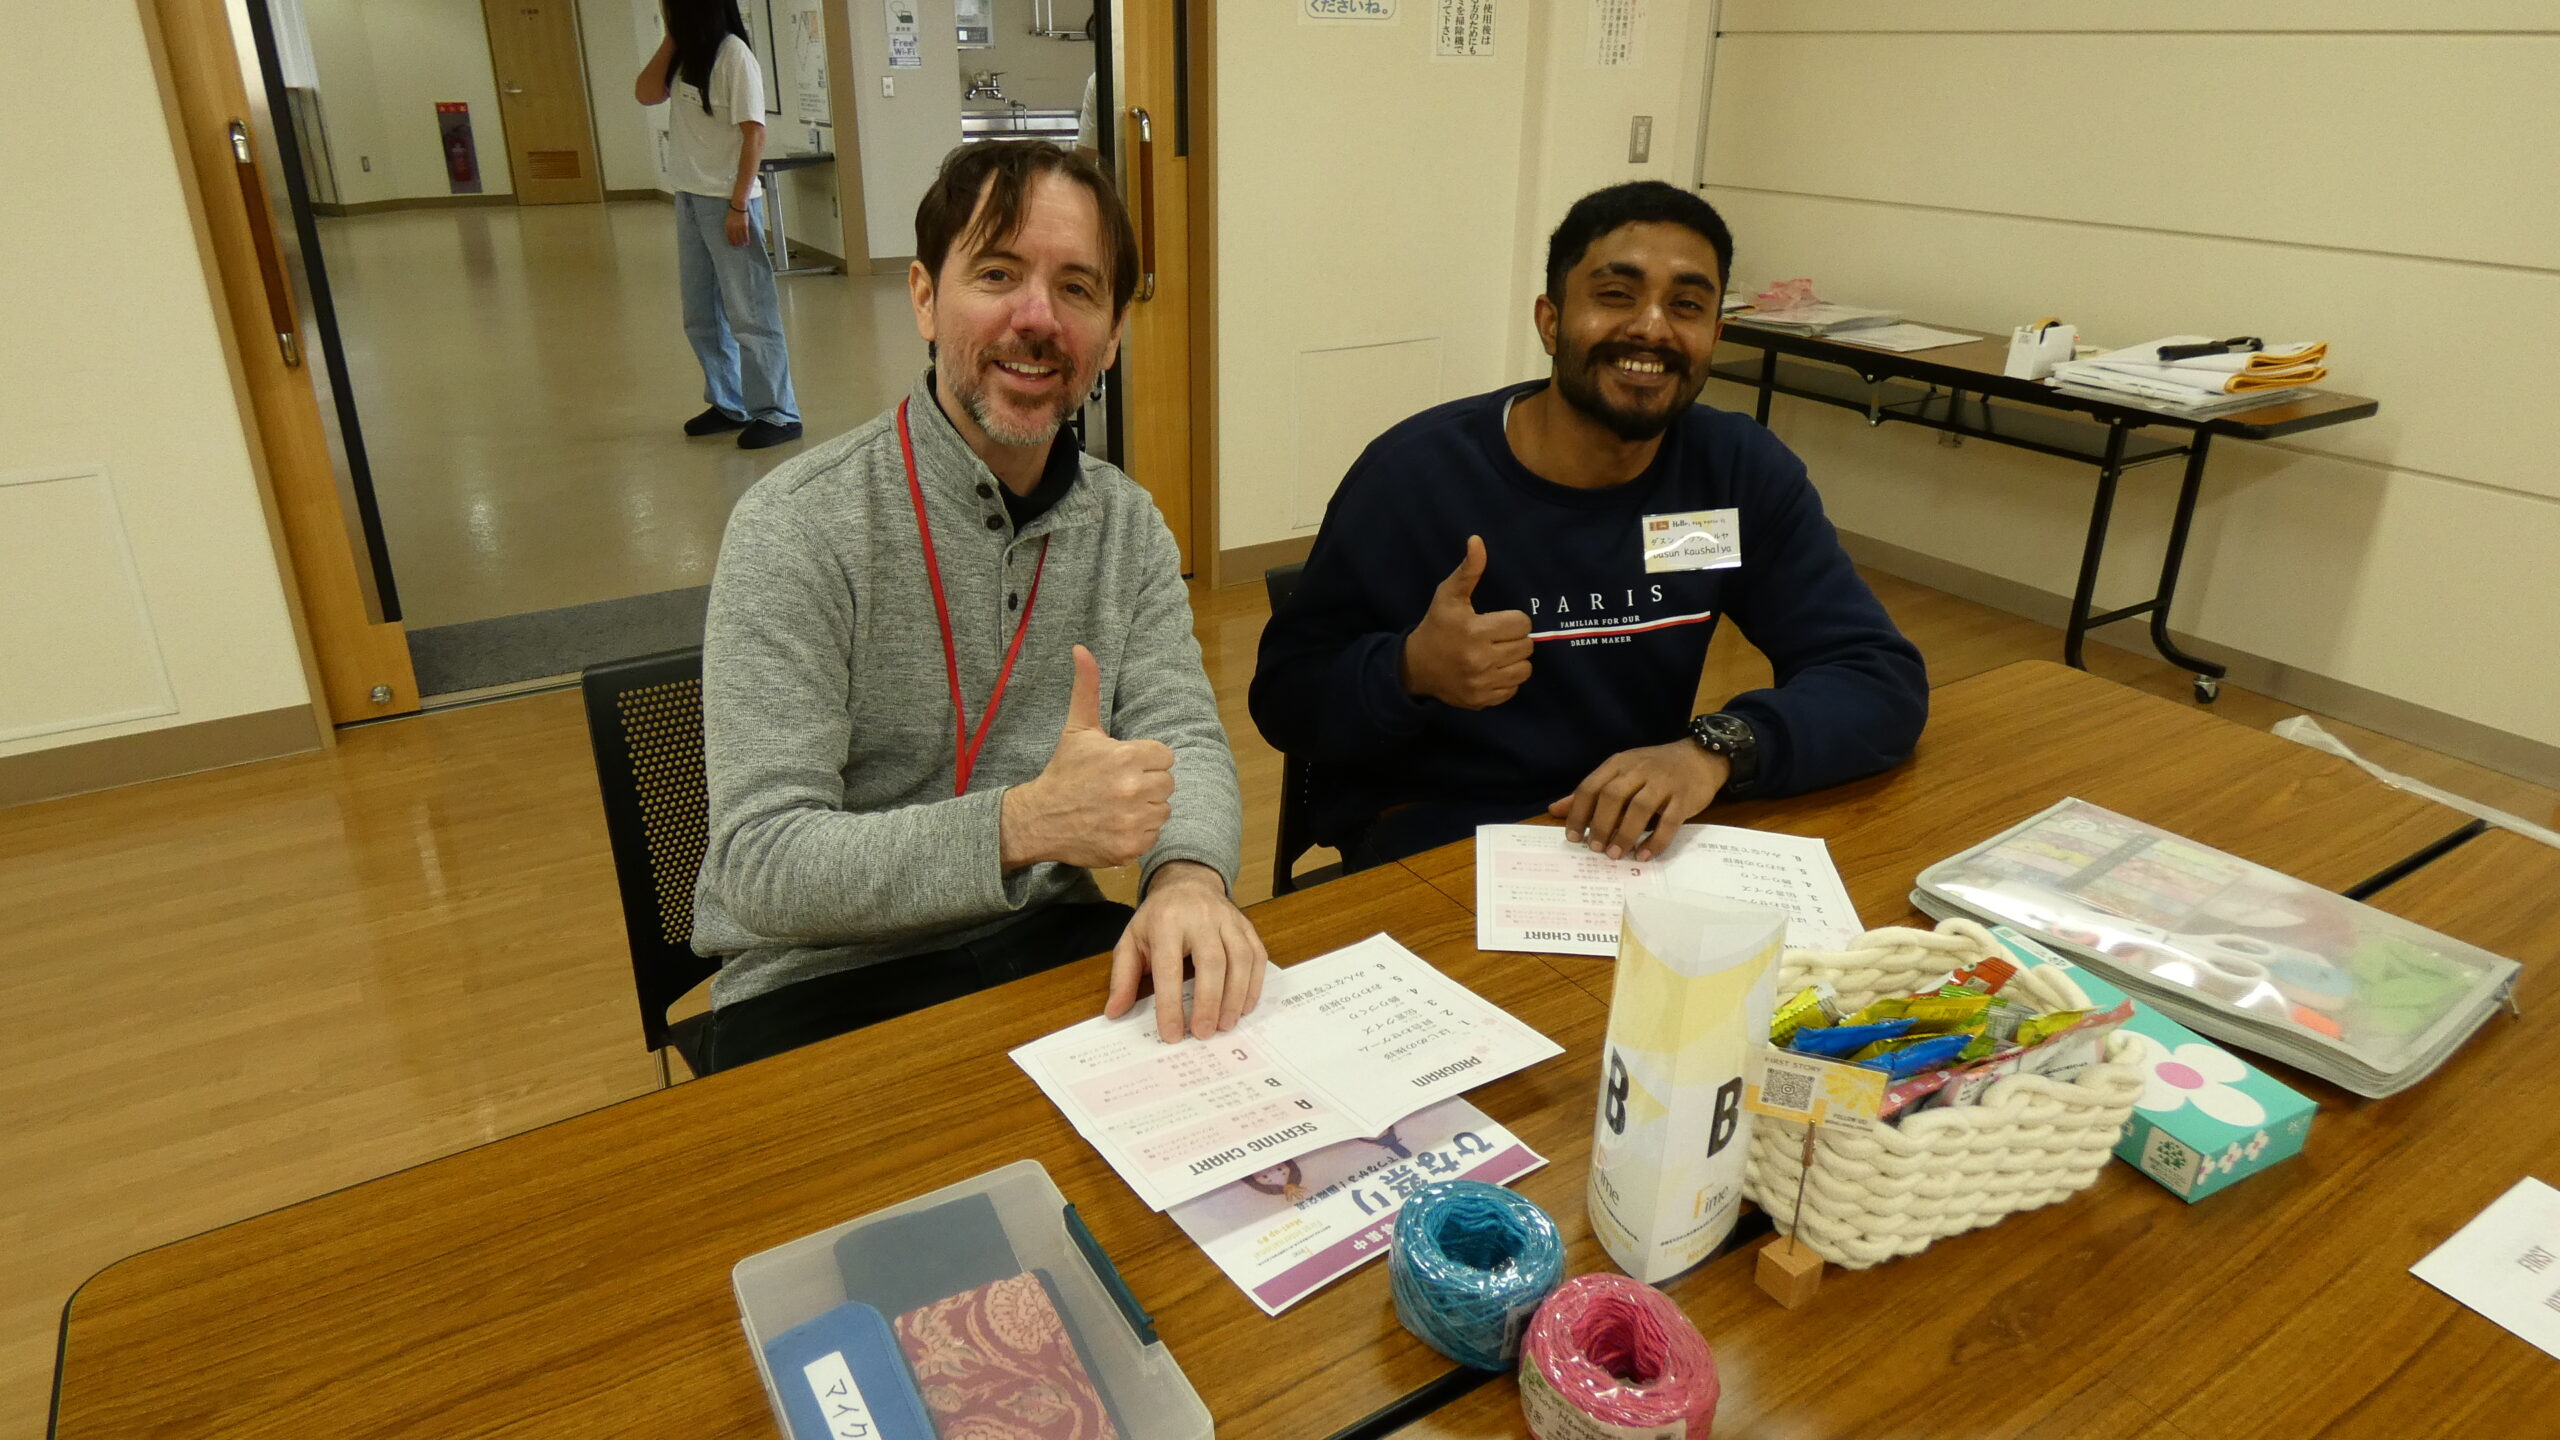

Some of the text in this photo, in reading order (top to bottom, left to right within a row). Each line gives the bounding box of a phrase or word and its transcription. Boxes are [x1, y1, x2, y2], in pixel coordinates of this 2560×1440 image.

[1311, 0, 1389, 14] くださいね。
[893, 38, 913, 48] Free
[894, 47, 916, 57] Wi-Fi
[1530, 584, 1663, 615] PARIS
[1560, 615, 1641, 629] FAMILIAR FOR OUR
[1570, 636, 1632, 647] DREAM MAKER
[1630, 868, 1641, 877] C
[1523, 930, 1619, 943] ATING CHART
[1281, 970, 1366, 1007] みんなで写真撮影
[1319, 983, 1383, 1013] おわりの挨拶
[1348, 996, 1401, 1020] 飾りづくり
[1358, 1019, 1434, 1052] 貝合わせゲーム
[1384, 1028, 1451, 1061] はじめの挨拶
[1231, 1048, 1248, 1061] C
[1764, 1057, 1822, 1073] FIRST STORY
[1264, 1077, 1282, 1088] B
[1411, 1055, 1483, 1087] PROGRAM
[1293, 1099, 1313, 1110] A
[1605, 1045, 1630, 1136] B
[1707, 1076, 1743, 1159] B
[1246, 1122, 1318, 1152] SEATING
[1187, 1147, 1247, 1176] CHART
[1351, 1131, 1495, 1216] ひな祭り
[2515, 1244, 2559, 1275] FIRST
[825, 1378, 868, 1438] マイク
